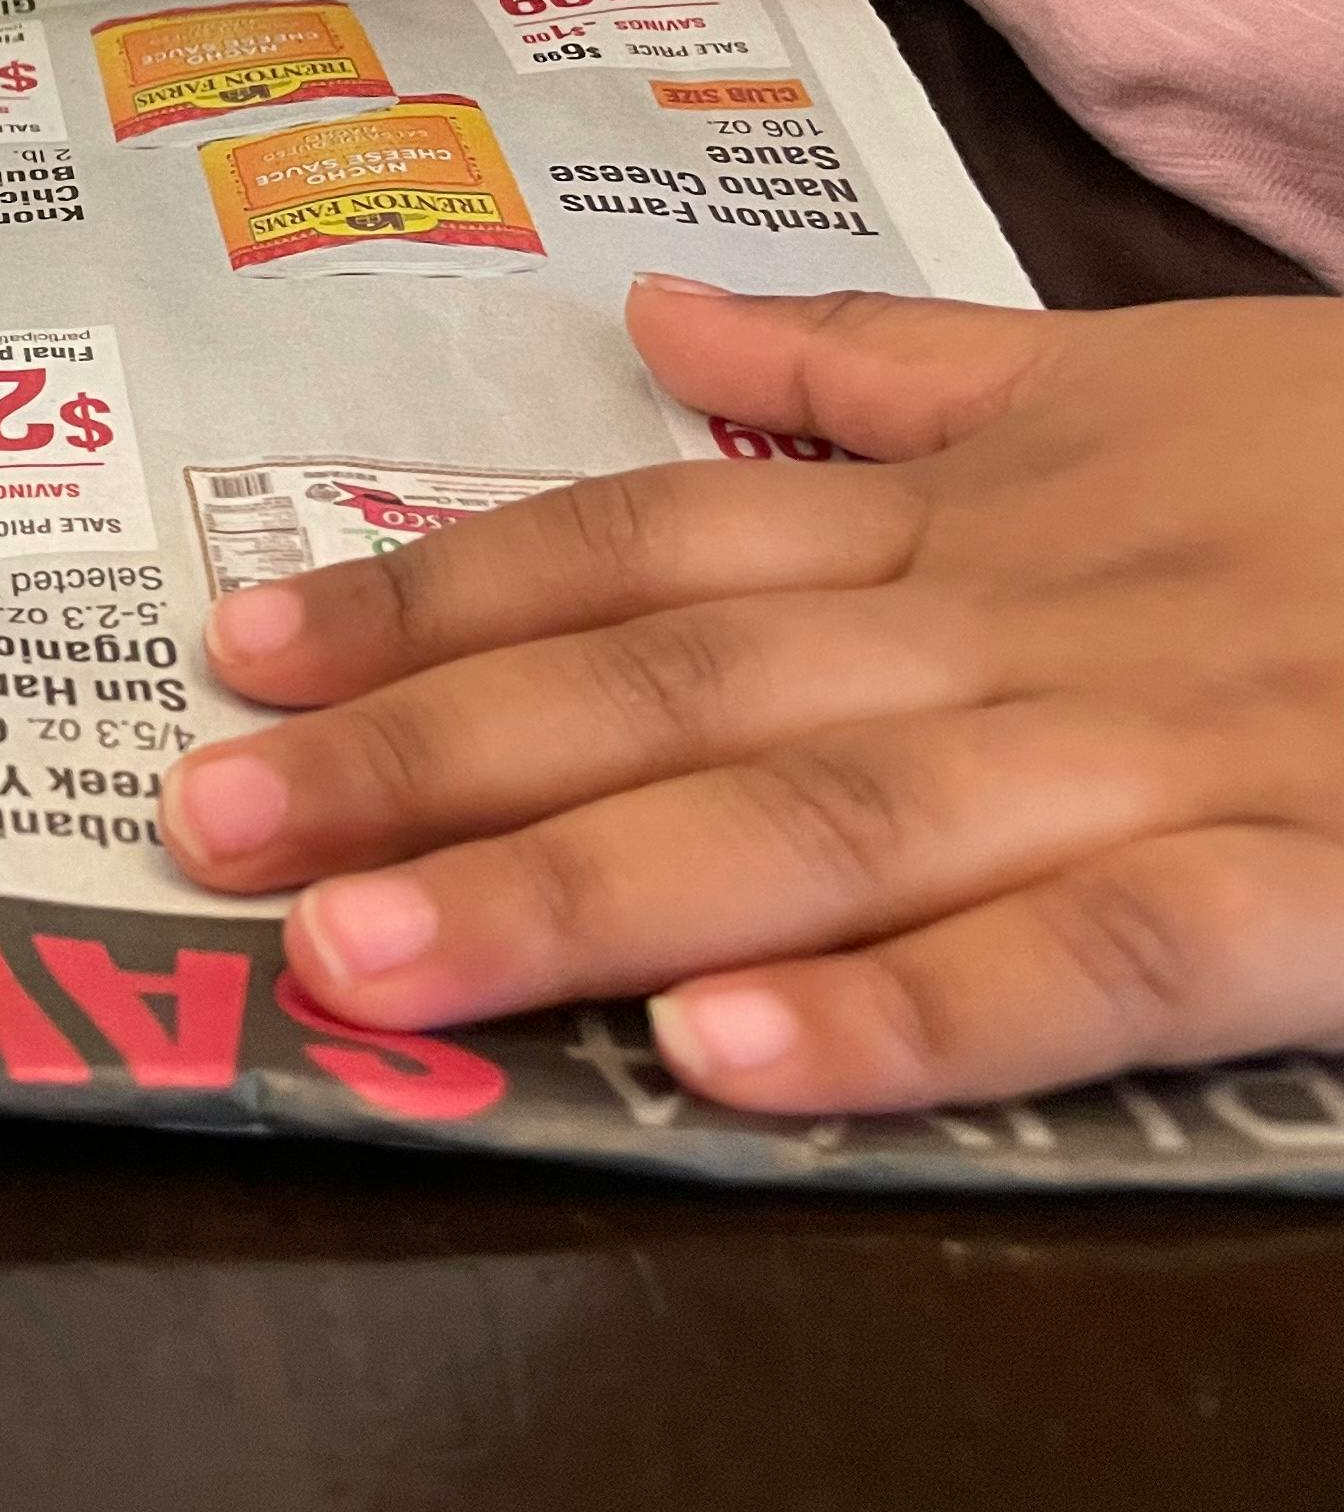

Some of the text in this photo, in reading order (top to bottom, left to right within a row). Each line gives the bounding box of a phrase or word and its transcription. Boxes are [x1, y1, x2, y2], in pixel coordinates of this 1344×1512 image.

[136, 60, 351, 107] TRENTON FARMS
[662, 87, 799, 103] CLUB SIZE
[707, 118, 823, 137] 106 oz.
[13, 149, 72, 163] 2 lb.
[255, 148, 452, 187] CHEESE SAUCE
[705, 144, 841, 170] Sauce
[305, 162, 407, 185] NACHO
[549, 165, 858, 202] Nacho Cheese
[253, 193, 494, 235] TRENTON FARMS
[559, 193, 878, 236] Trenton Farms
[23, 346, 94, 362] Final
[60, 518, 122, 534] SALE
[11, 566, 162, 595] Selected
[61, 601, 167, 628] .5-2.3
[95, 678, 187, 710] Sun
[26, 718, 81, 742] oz.
[95, 719, 196, 751] 4/5.3
[46, 767, 161, 800] reek
